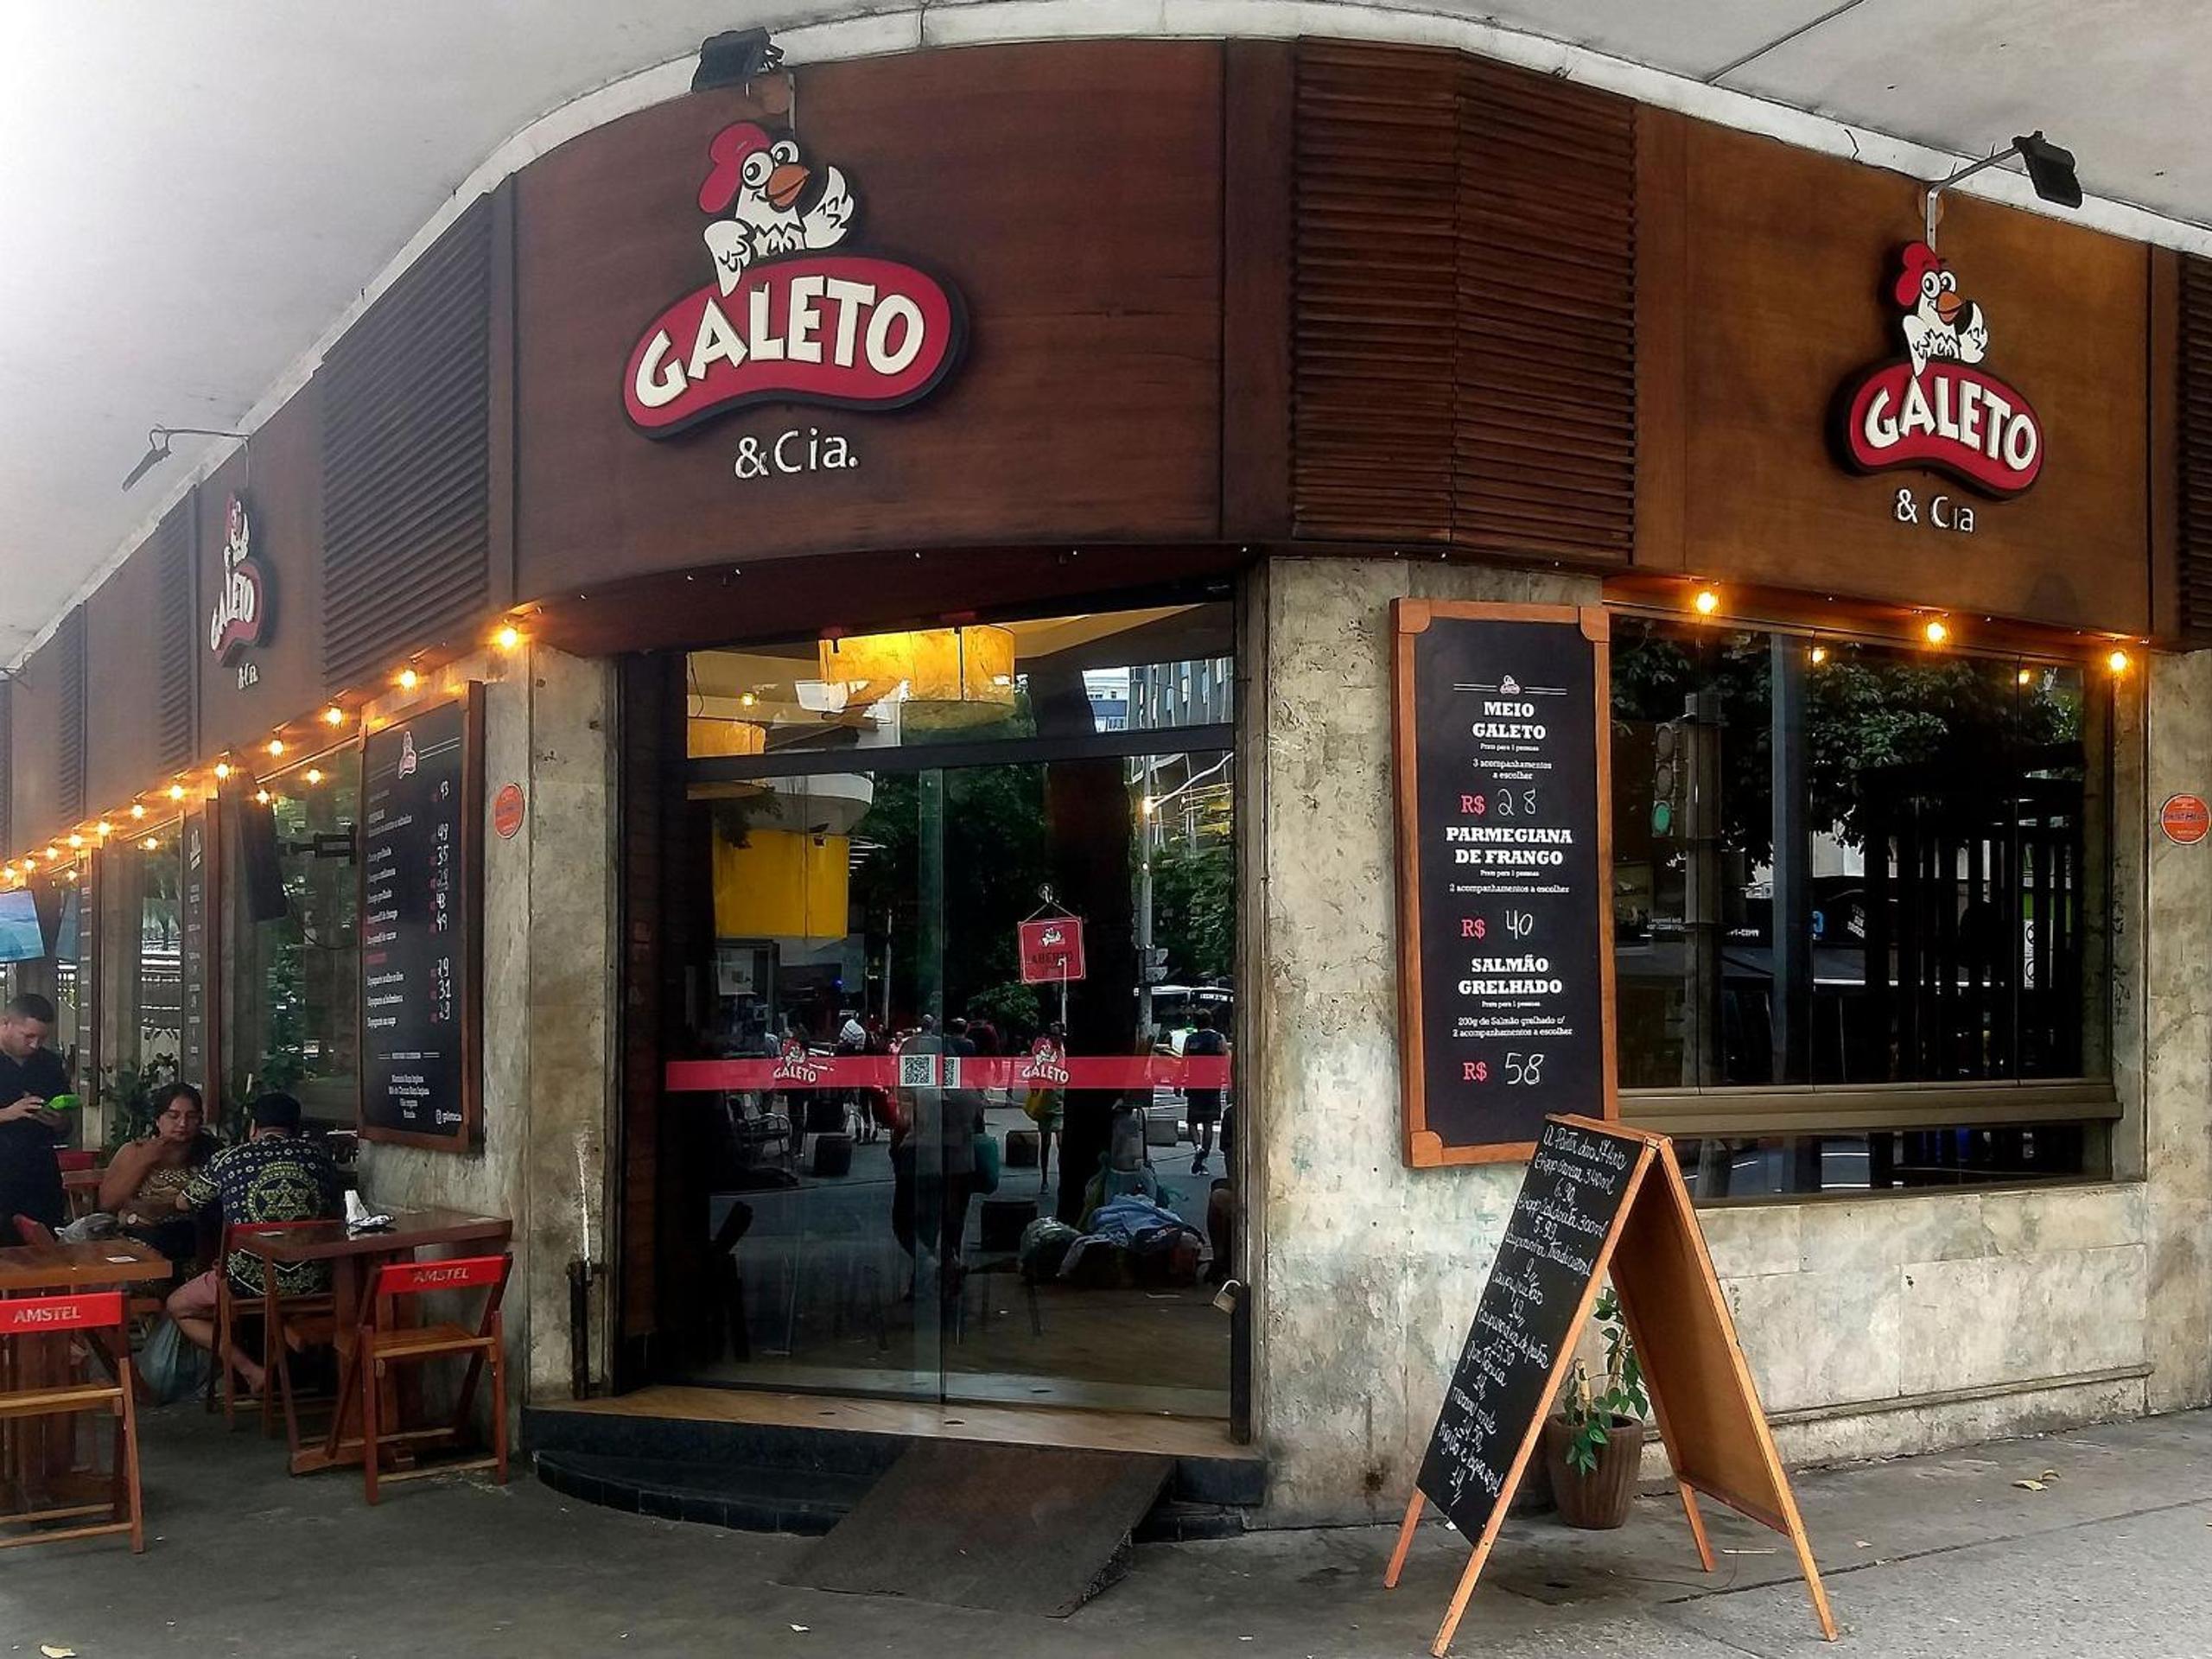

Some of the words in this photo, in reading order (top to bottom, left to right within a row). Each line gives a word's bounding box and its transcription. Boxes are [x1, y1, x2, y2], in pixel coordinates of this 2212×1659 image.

[635, 275, 925, 409] GALETO
[1865, 374, 2037, 472] GALETO
[1484, 702, 1535, 717] MEIO
[1472, 723, 1546, 740] GALETO
[1472, 758, 1478, 767] 3
[1480, 760, 1552, 769] acompanhamentos
[1460, 794, 1485, 815] R$
[1446, 827, 1573, 844] PARMEGIANA
[1455, 849, 1480, 864] DE
[1484, 849, 1563, 865] FRANGO
[1449, 883, 1454, 892] 2
[1457, 884, 1529, 893] acompanhamentos
[1460, 918, 1486, 938] R$
[1505, 909, 1533, 940] 40
[1471, 954, 1549, 973] SALMÃO
[1458, 979, 1563, 995] GRELHADO
[1459, 1028, 1531, 1038] acompanhamentos
[773, 1065, 817, 1084] GALETO
[1021, 1064, 1070, 1085] GALETO
[1462, 1061, 1488, 1082] R$
[1504, 1052, 1544, 1086] 58
[413, 1268, 470, 1283] AMSTEL
[14, 1306, 80, 1324] AMSTEL
